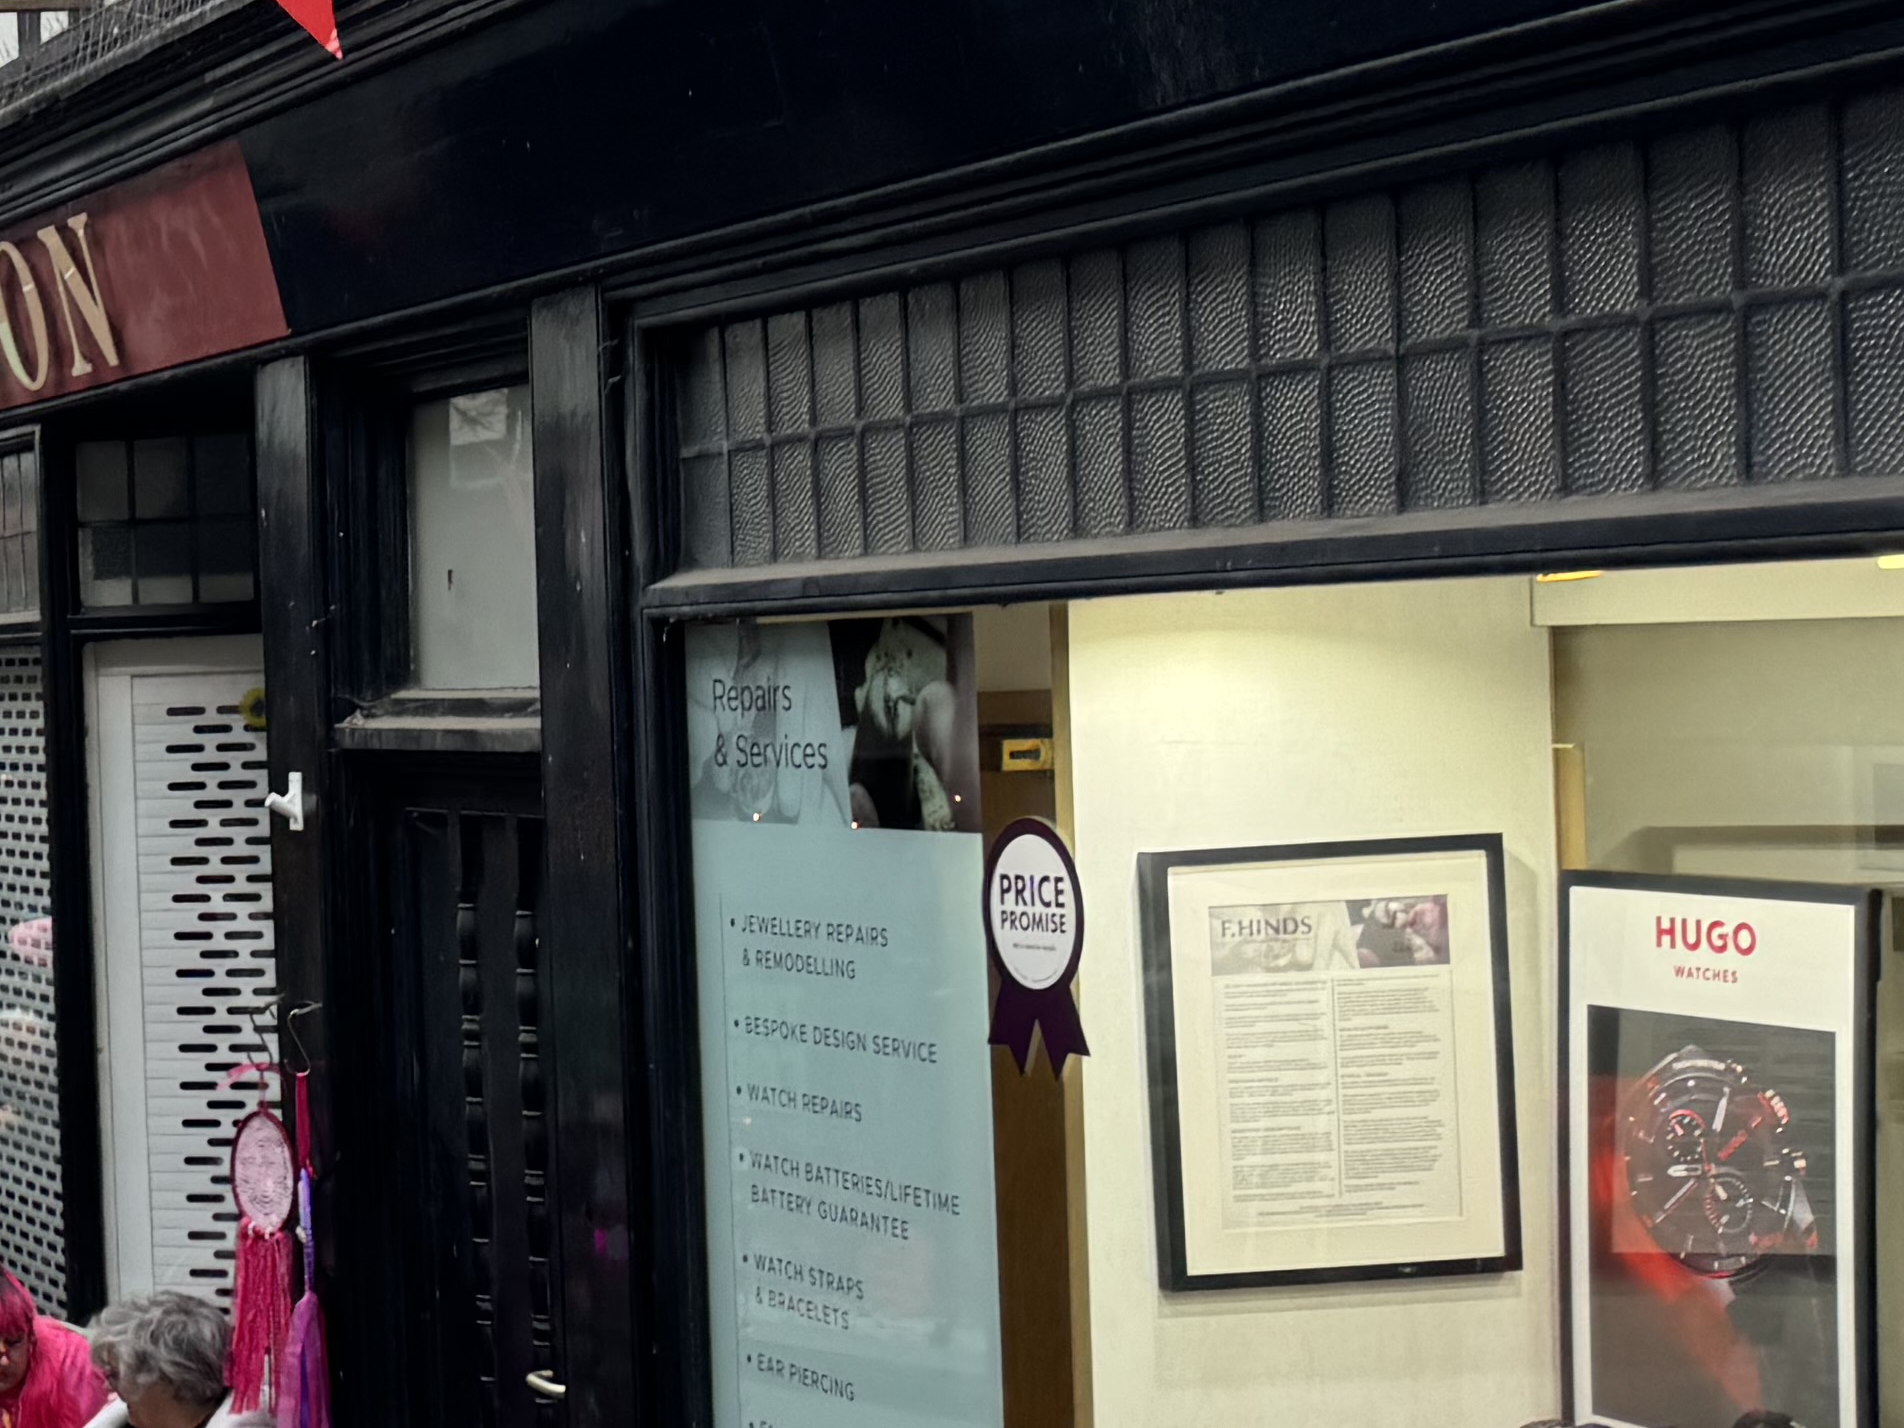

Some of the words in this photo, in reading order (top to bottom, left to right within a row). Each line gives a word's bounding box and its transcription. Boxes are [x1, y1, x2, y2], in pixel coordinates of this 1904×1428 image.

[712, 677, 791, 718] Repairs
[713, 732, 727, 767] &
[735, 733, 827, 769] Services
[999, 873, 1066, 909] PRICE
[741, 914, 820, 938] JEWELLERY
[826, 922, 888, 947] REPAIRS
[1000, 909, 1067, 934] PROMISE
[1221, 915, 1314, 938] F.HINDS
[1655, 915, 1757, 957] HUGO
[742, 947, 750, 966] &
[755, 949, 855, 979] REMODELLING
[1674, 964, 1739, 984] WATCHES
[744, 1015, 807, 1043] BESPOKE
[812, 1025, 866, 1051] DESIGN
[872, 1035, 936, 1063] SERVICE
[747, 1083, 796, 1108] WATCH
[802, 1093, 861, 1122] REPAIRS
[751, 1152, 799, 1177] WATCH
[804, 1162, 958, 1215] BATTERIES/LIFETIME
[751, 1184, 811, 1214] BATTERY
[817, 1200, 908, 1239] GUARANTEE
[753, 1254, 803, 1281] WATCH
[808, 1267, 863, 1299] STRAPS
[755, 1285, 763, 1304] &
[768, 1289, 848, 1329] BRACELETS
[756, 1352, 784, 1376] EAR
[789, 1363, 854, 1401] PIERCING
